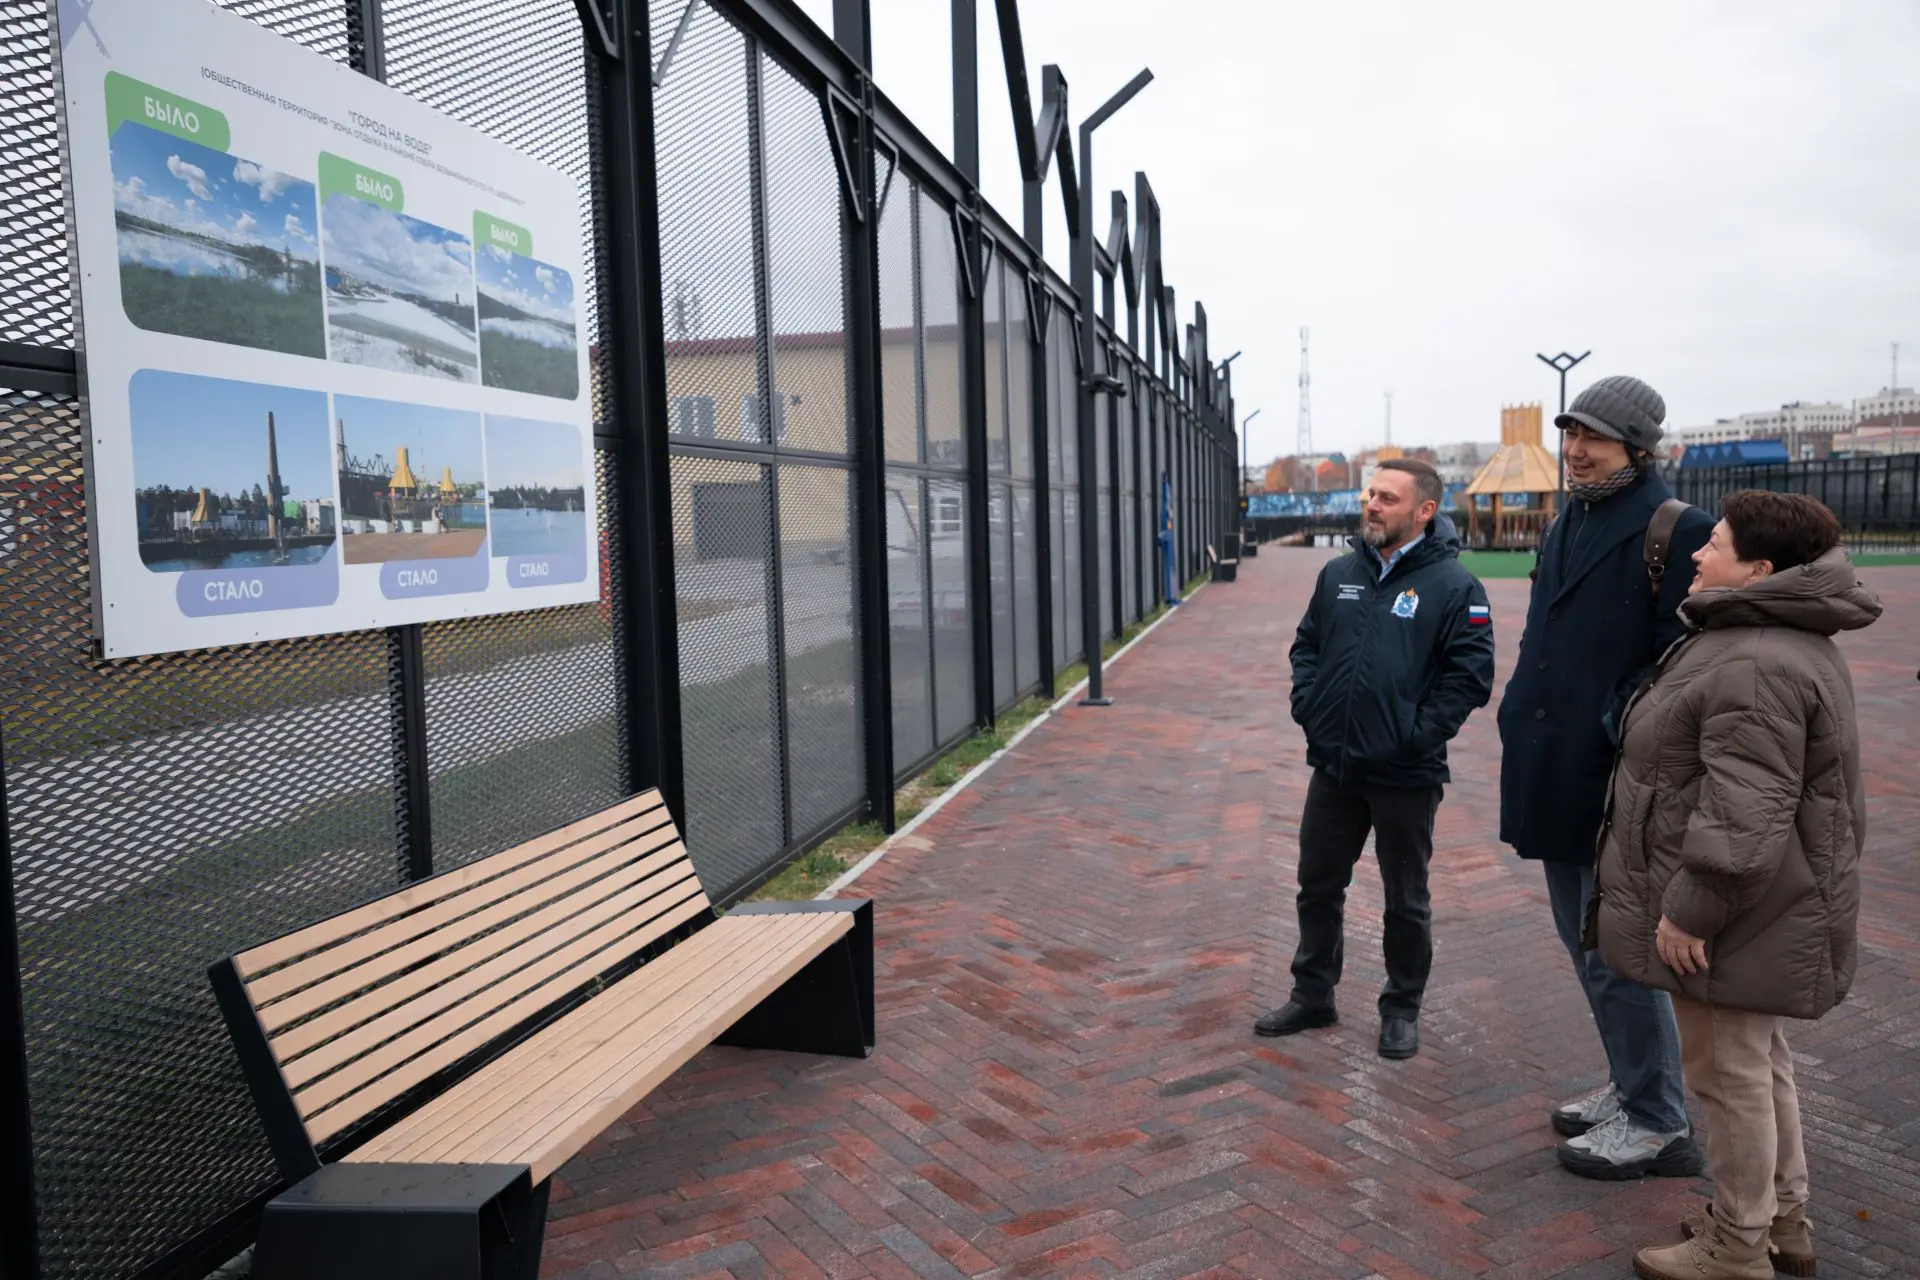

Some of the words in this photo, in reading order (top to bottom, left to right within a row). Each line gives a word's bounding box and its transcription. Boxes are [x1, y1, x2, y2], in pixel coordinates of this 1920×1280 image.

[144, 95, 200, 133] БЫЛО
[278, 98, 328, 125] ТЕРРИТОРИЯ
[389, 127, 402, 142] НА
[355, 173, 394, 202] БЫЛО
[490, 223, 518, 247] БЫЛО
[397, 568, 438, 587] СТАЛО
[519, 562, 549, 578] СТАЛО
[204, 579, 263, 602] СТАЛО
